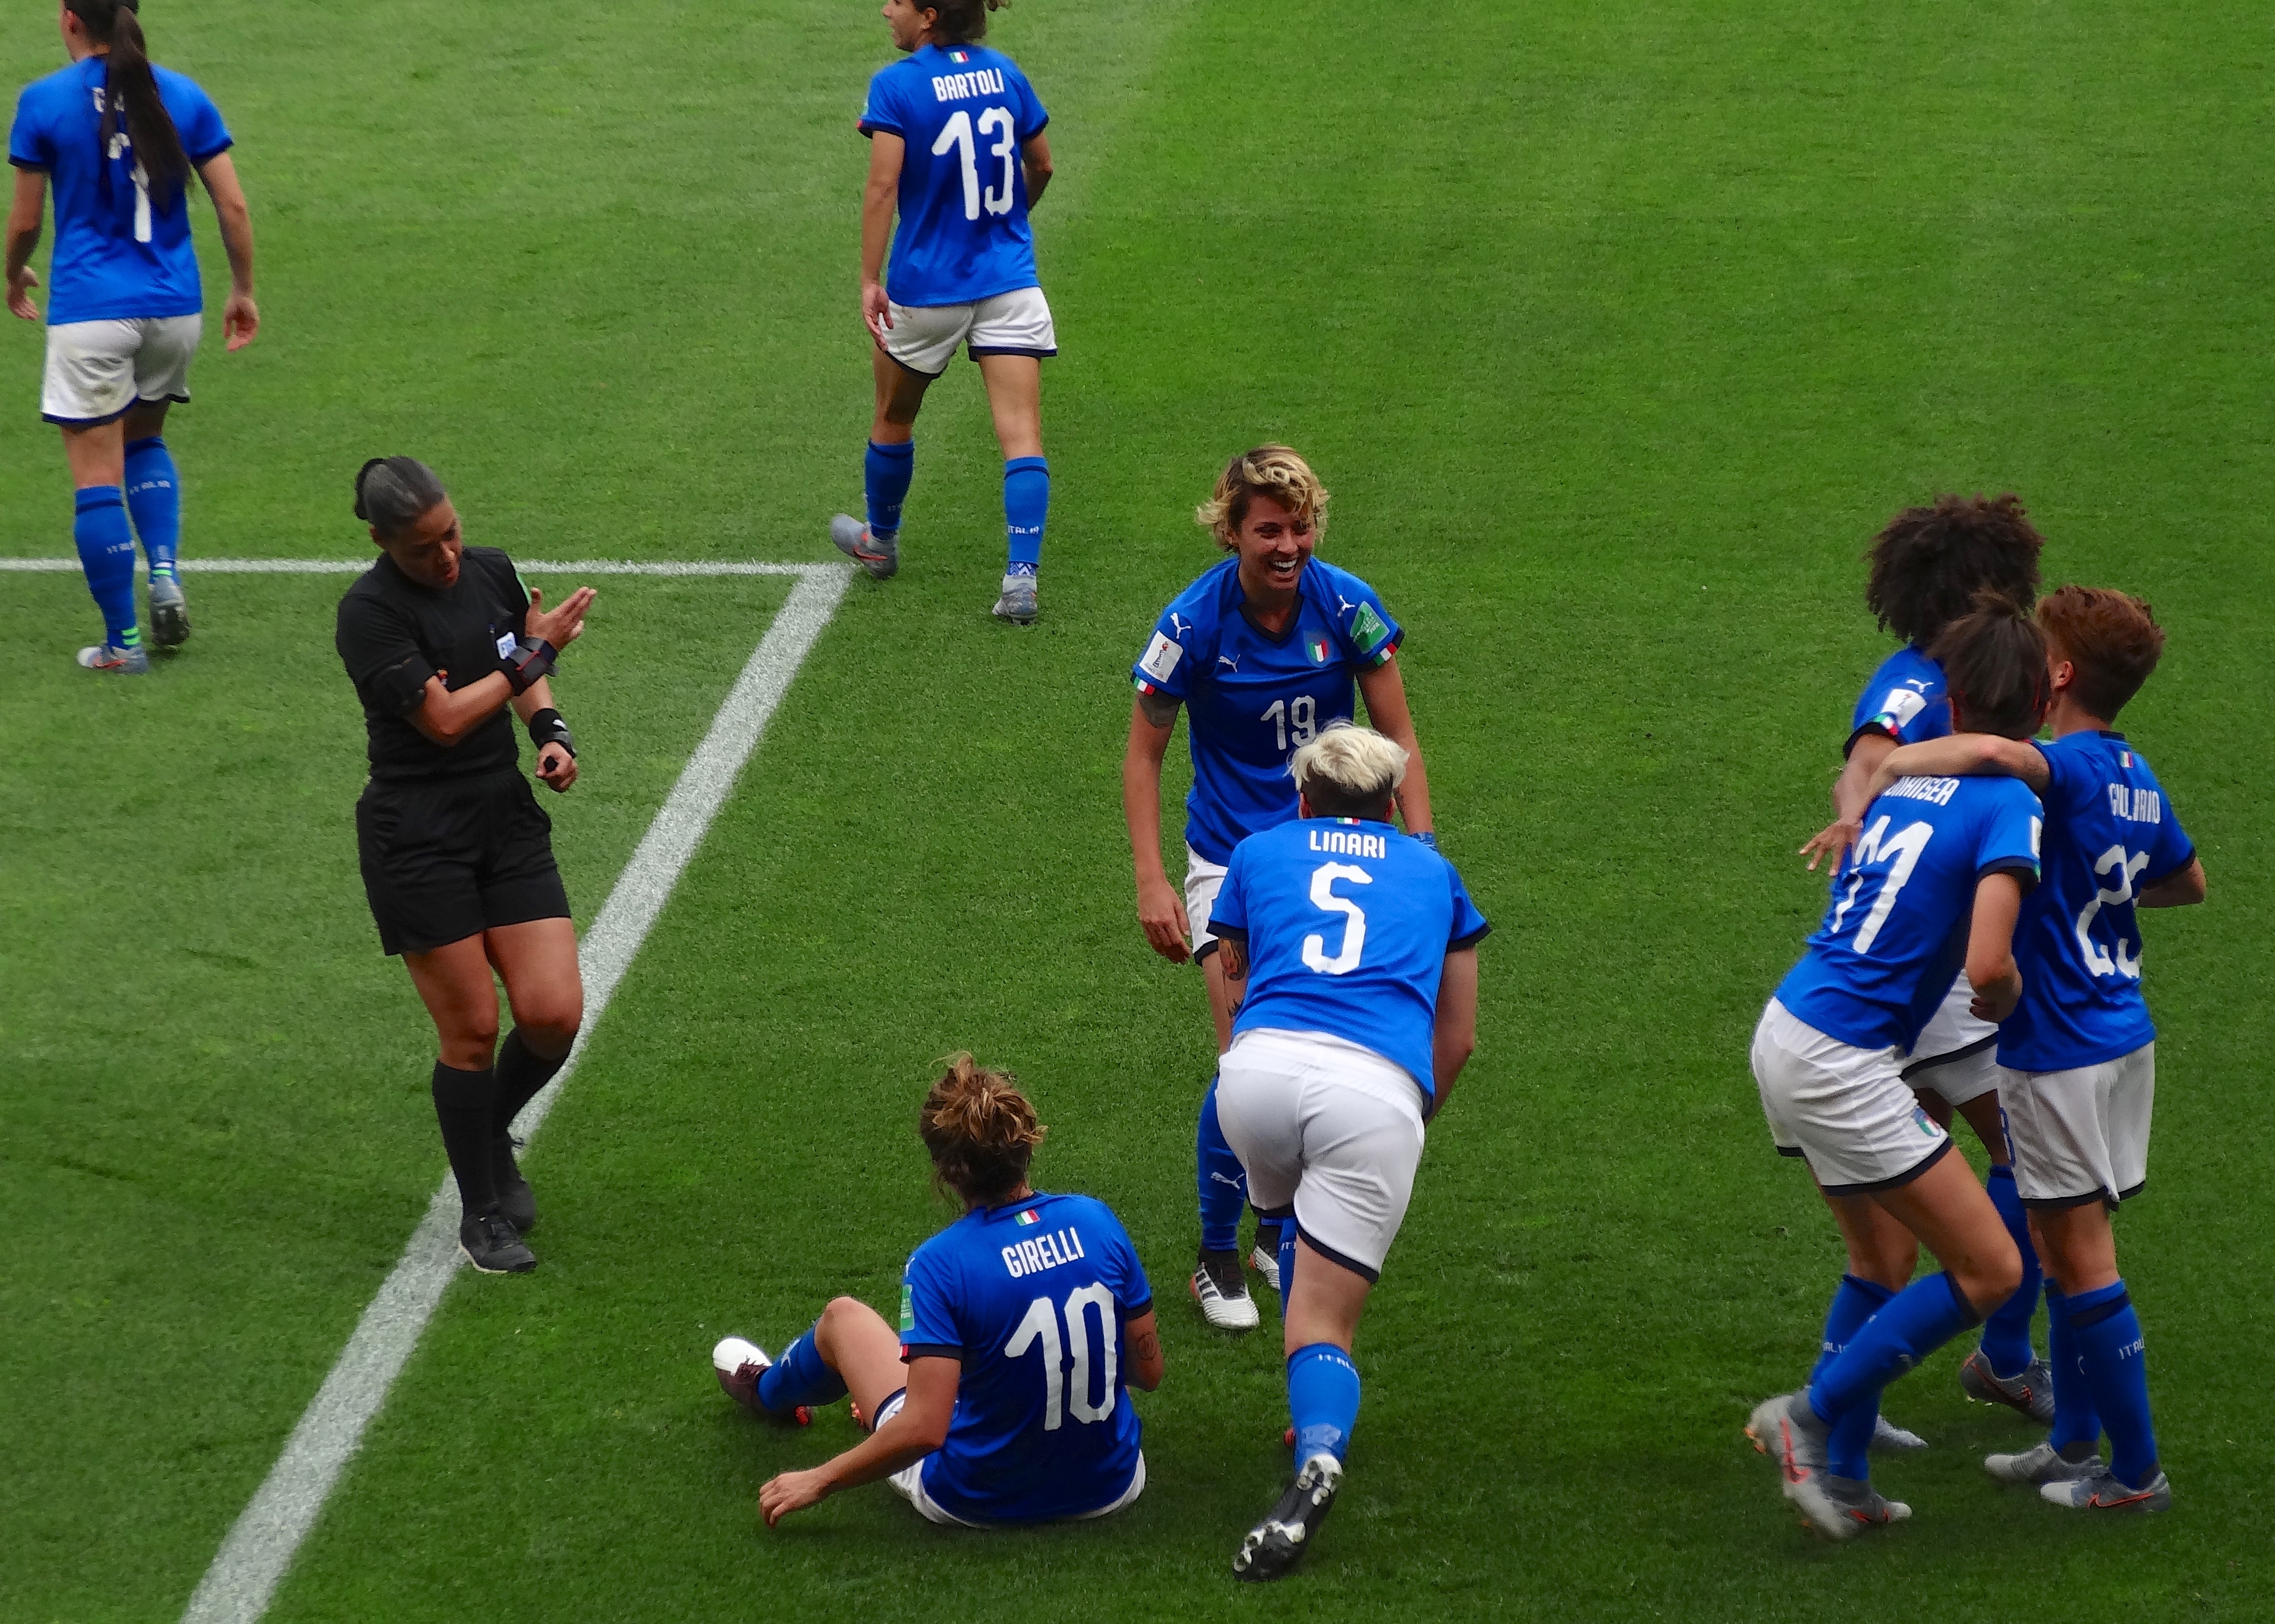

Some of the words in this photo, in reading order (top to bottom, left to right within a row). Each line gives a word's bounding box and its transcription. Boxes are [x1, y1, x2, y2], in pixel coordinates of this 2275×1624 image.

[931, 67, 1006, 102] BARTOLI
[931, 106, 1015, 221] 13
[1260, 695, 1316, 750] 19
[1309, 830, 1385, 859] LINARI
[1302, 861, 1373, 975] 5
[1001, 1227, 1085, 1278] GIRELLI
[1004, 1281, 1118, 1431] 10
